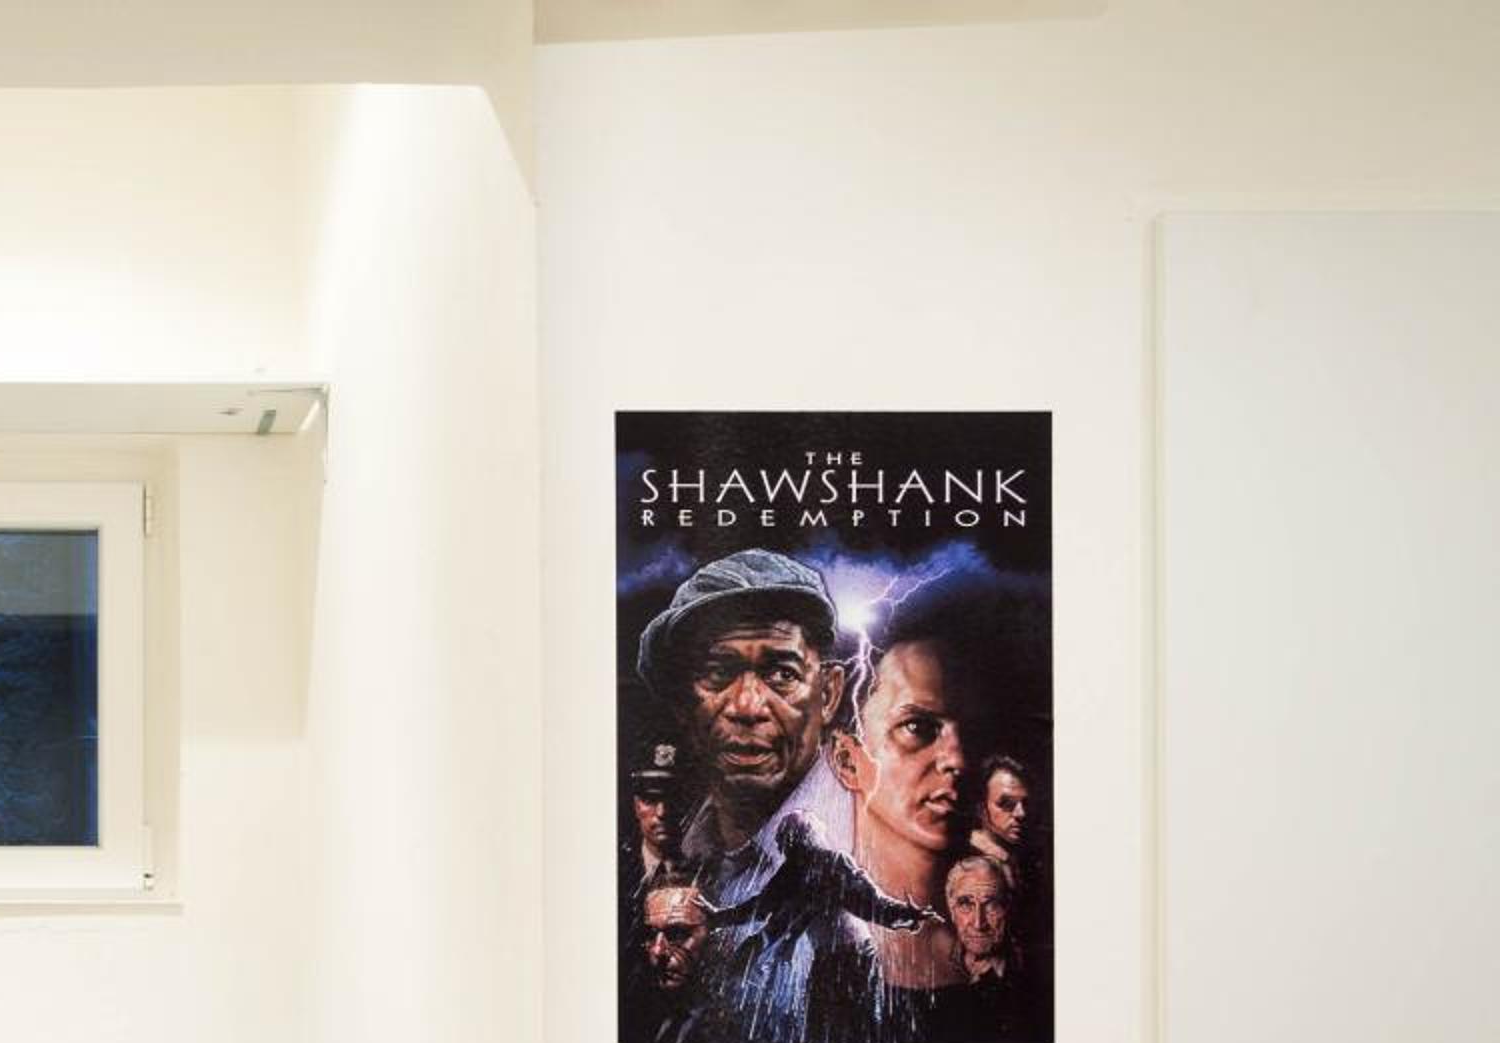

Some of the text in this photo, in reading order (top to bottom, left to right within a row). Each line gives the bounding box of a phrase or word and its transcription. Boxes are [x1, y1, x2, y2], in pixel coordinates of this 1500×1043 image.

[805, 451, 863, 466] THE
[640, 468, 1027, 505] SHAWSHANK
[640, 508, 1027, 528] REDEMPTION
